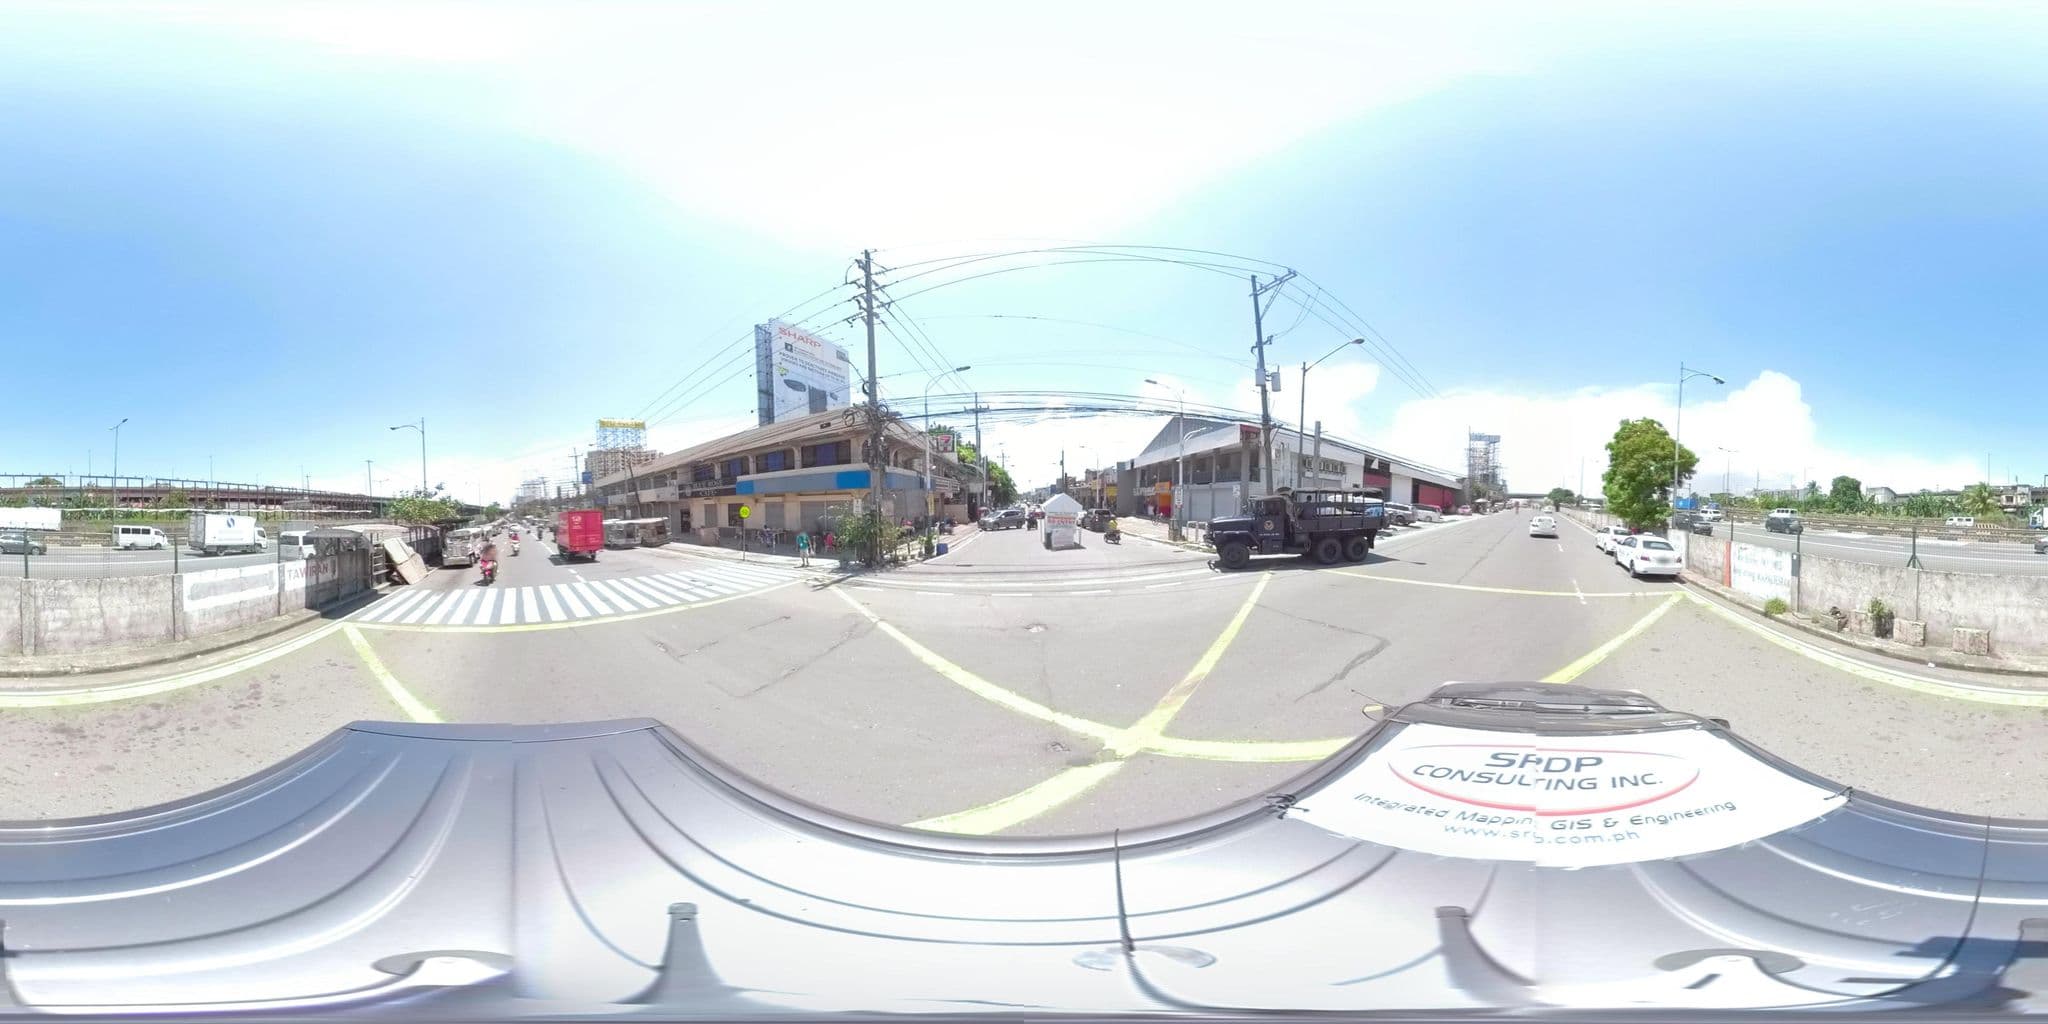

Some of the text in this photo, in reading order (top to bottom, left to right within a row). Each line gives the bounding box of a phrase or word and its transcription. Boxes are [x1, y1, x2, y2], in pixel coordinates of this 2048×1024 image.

[779, 327, 822, 347] SHARP
[287, 563, 329, 580] TAWIRAN
[1611, 772, 1663, 789] INC.
[1354, 793, 1737, 830] Integrated Mappin GIS & Engineering
